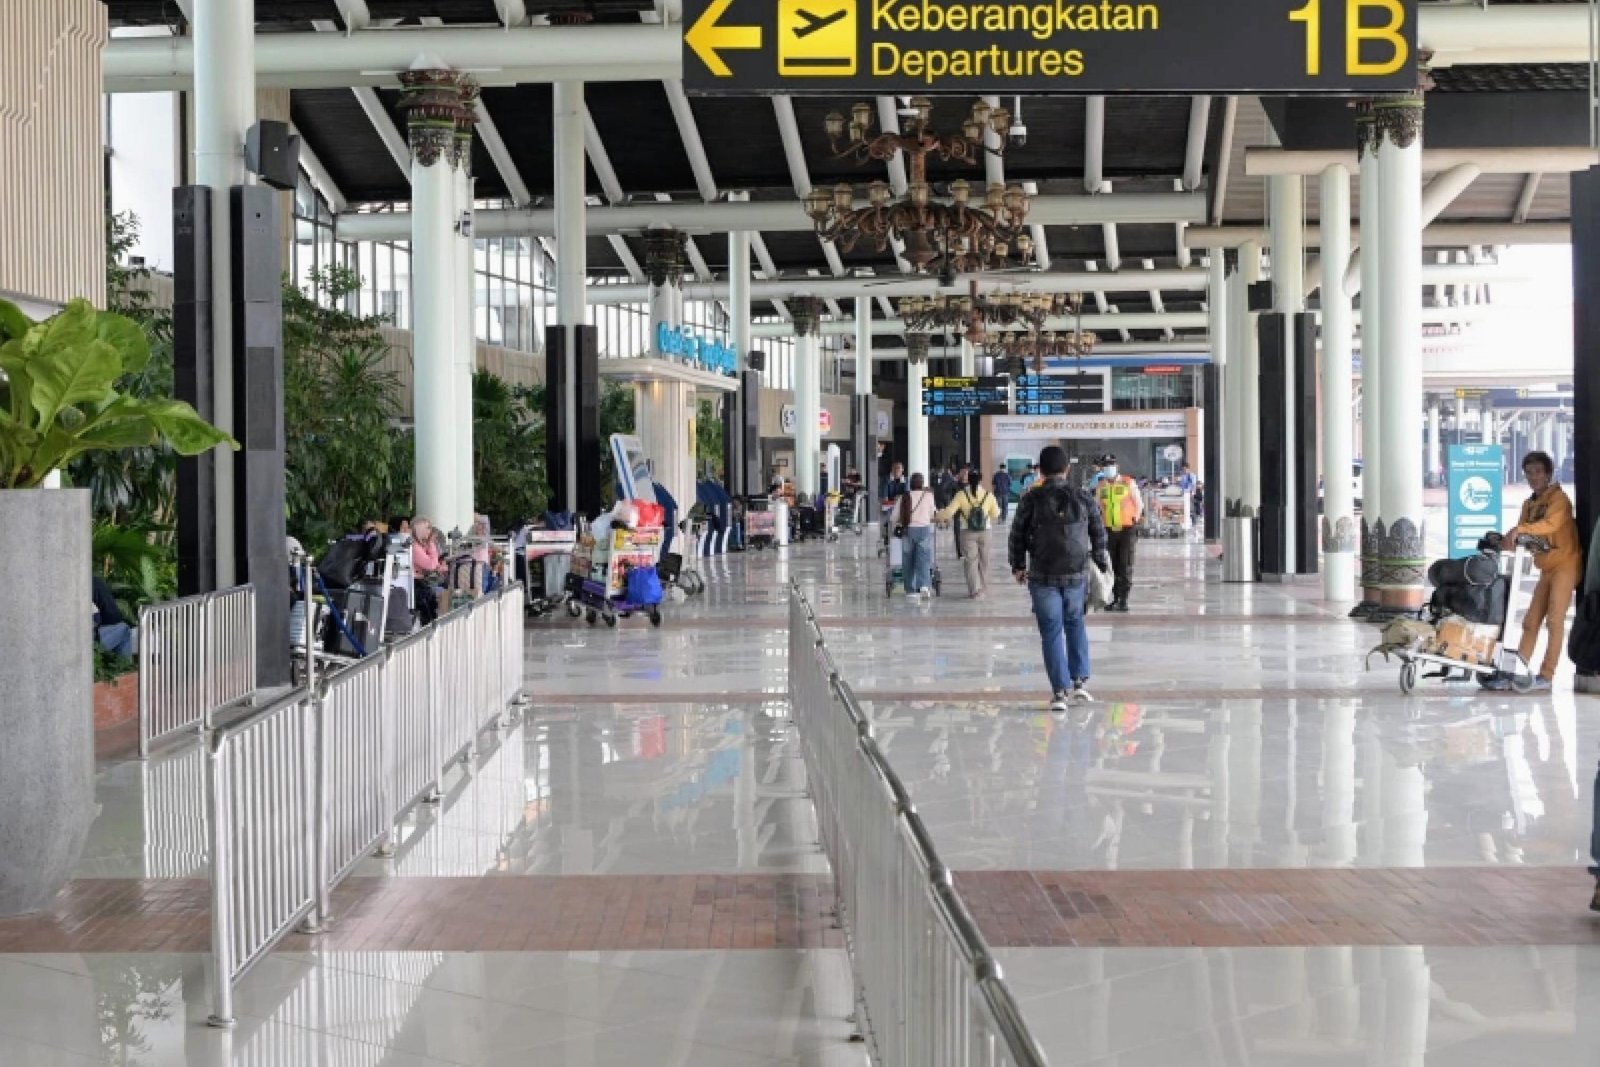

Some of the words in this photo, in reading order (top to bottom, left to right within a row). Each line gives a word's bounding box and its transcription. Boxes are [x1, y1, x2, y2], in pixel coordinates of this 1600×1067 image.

[871, 0, 1159, 39] Keberangkatan
[1289, 0, 1409, 75] 1B
[871, 42, 1085, 84] Departures
